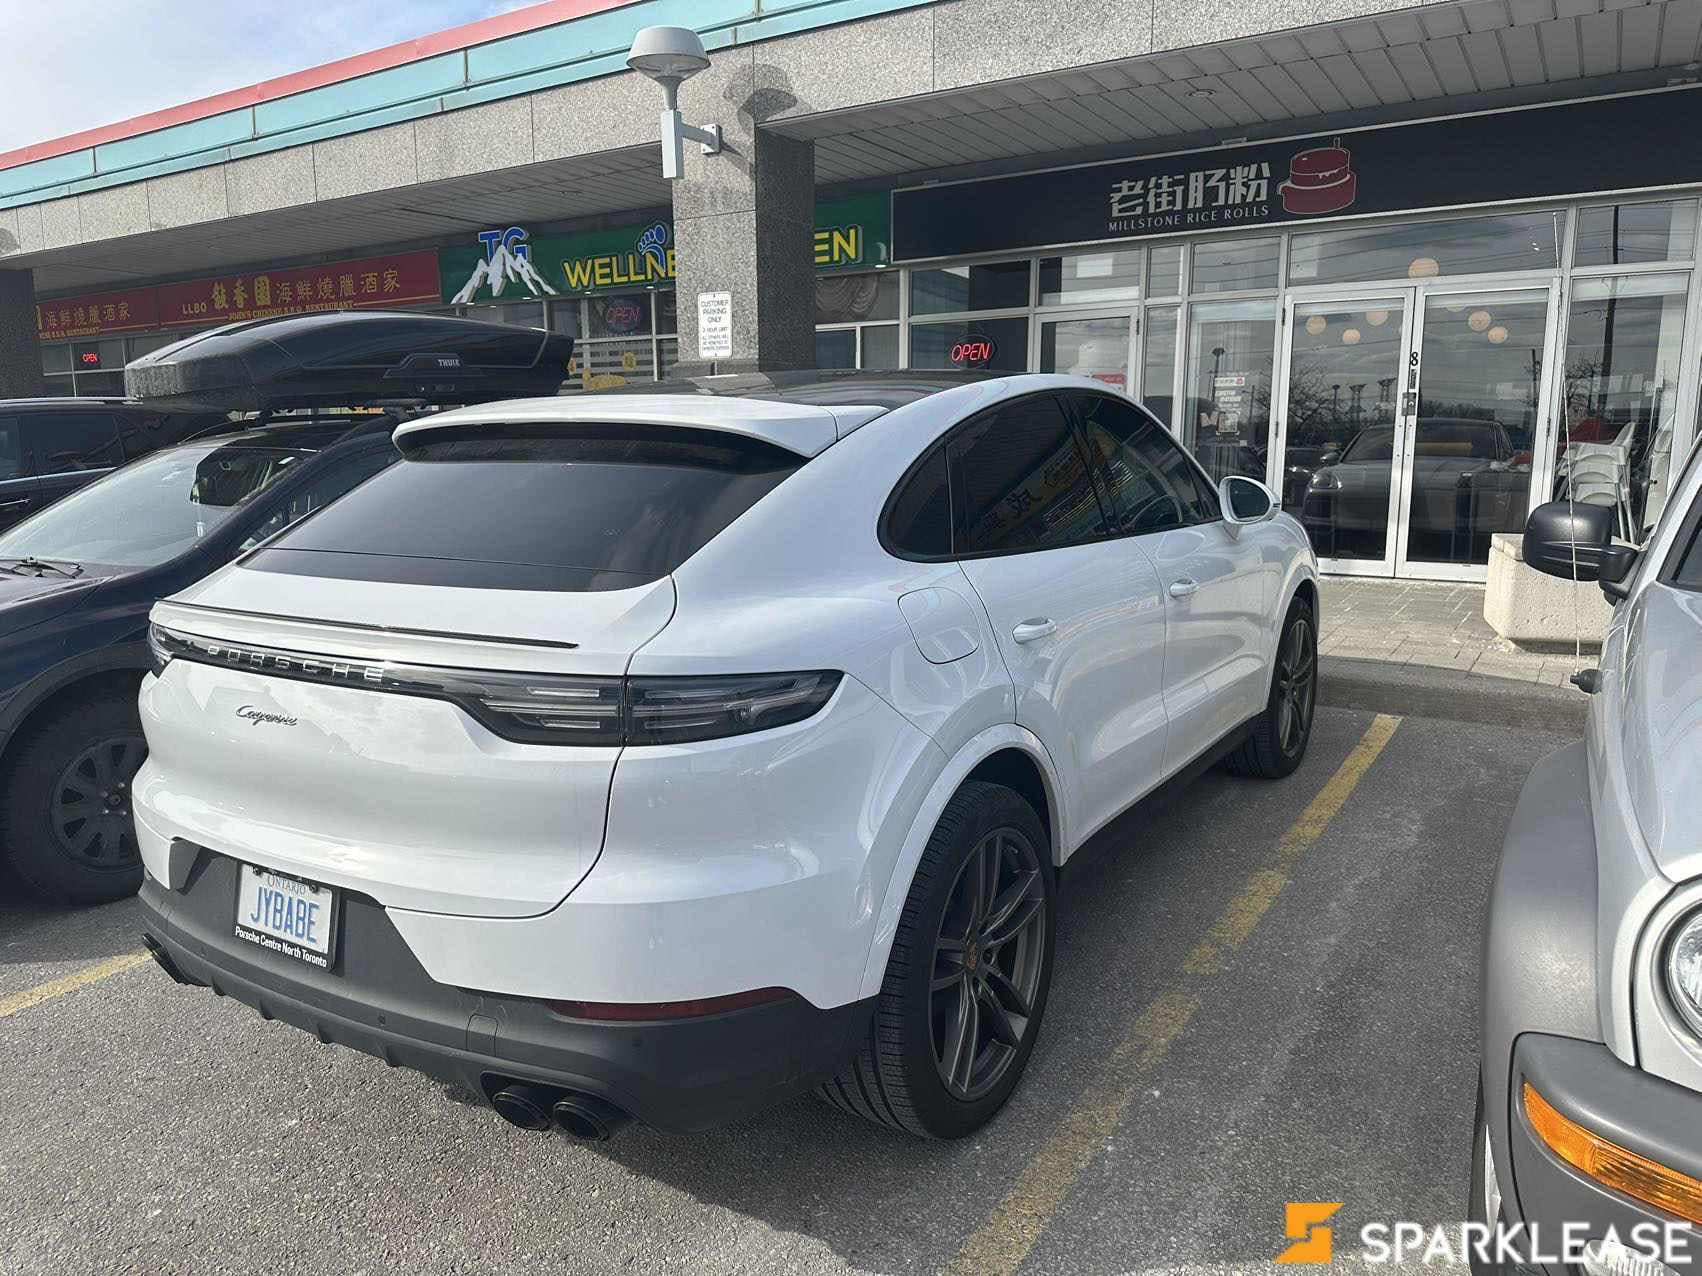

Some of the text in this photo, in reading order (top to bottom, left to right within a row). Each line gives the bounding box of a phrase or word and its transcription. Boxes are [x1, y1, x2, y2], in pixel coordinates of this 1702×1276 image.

[1110, 162, 1271, 218] 老街肠粉
[1108, 205, 1269, 232] MILLSTONE RICE ROLLS
[478, 227, 529, 264] TG
[182, 302, 207, 315] LLBO
[82, 352, 98, 363] OPEN
[437, 358, 460, 368] THULE
[951, 341, 991, 362] OPEN
[1410, 351, 1419, 367] 8
[207, 645, 385, 683] PORSCHE
[235, 704, 299, 727] Cayenne
[250, 886, 320, 944] JYBABE
[235, 926, 327, 968] Porsche Centre North Toronto
